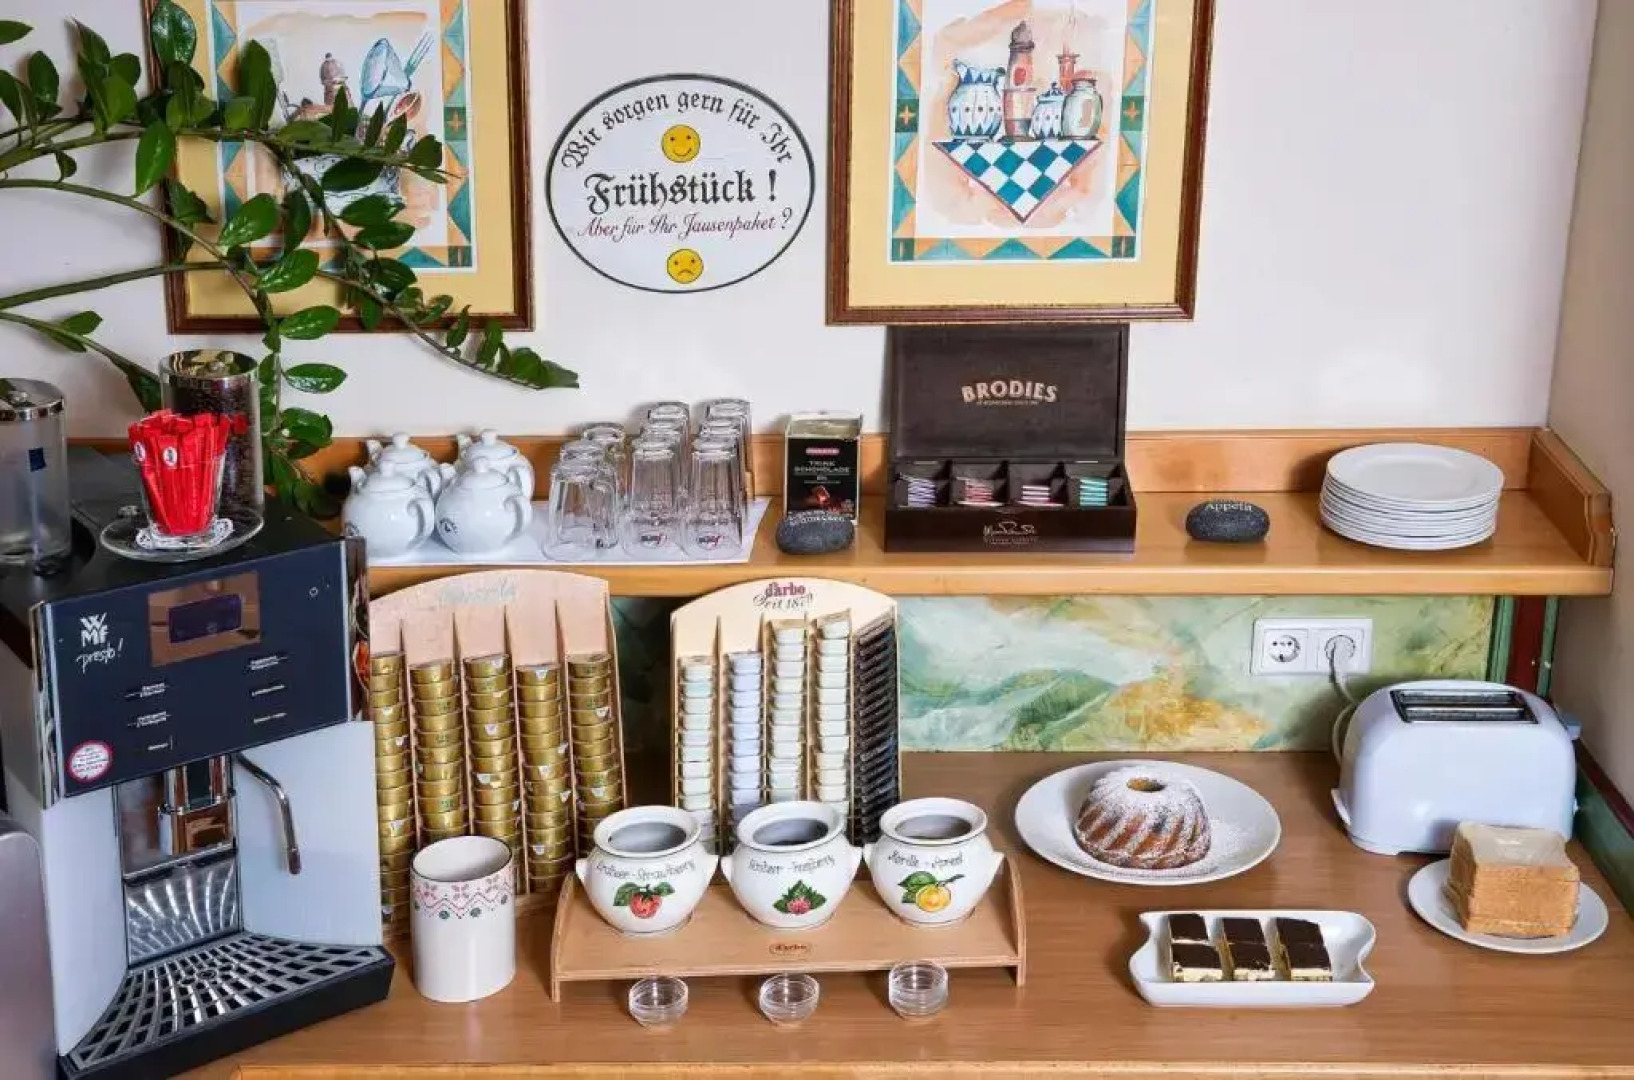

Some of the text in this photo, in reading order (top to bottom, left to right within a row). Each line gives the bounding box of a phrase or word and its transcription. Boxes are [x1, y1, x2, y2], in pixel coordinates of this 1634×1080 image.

[561, 90, 793, 169] Wir sorgen gern für Ihr
[583, 169, 757, 216] Frühstück
[576, 215, 619, 238] Aber
[612, 215, 645, 243] für
[649, 215, 678, 237] Ihr
[677, 211, 776, 241] Jausenpaket
[962, 380, 1059, 403] BRODIES
[80, 612, 109, 647] WMF
